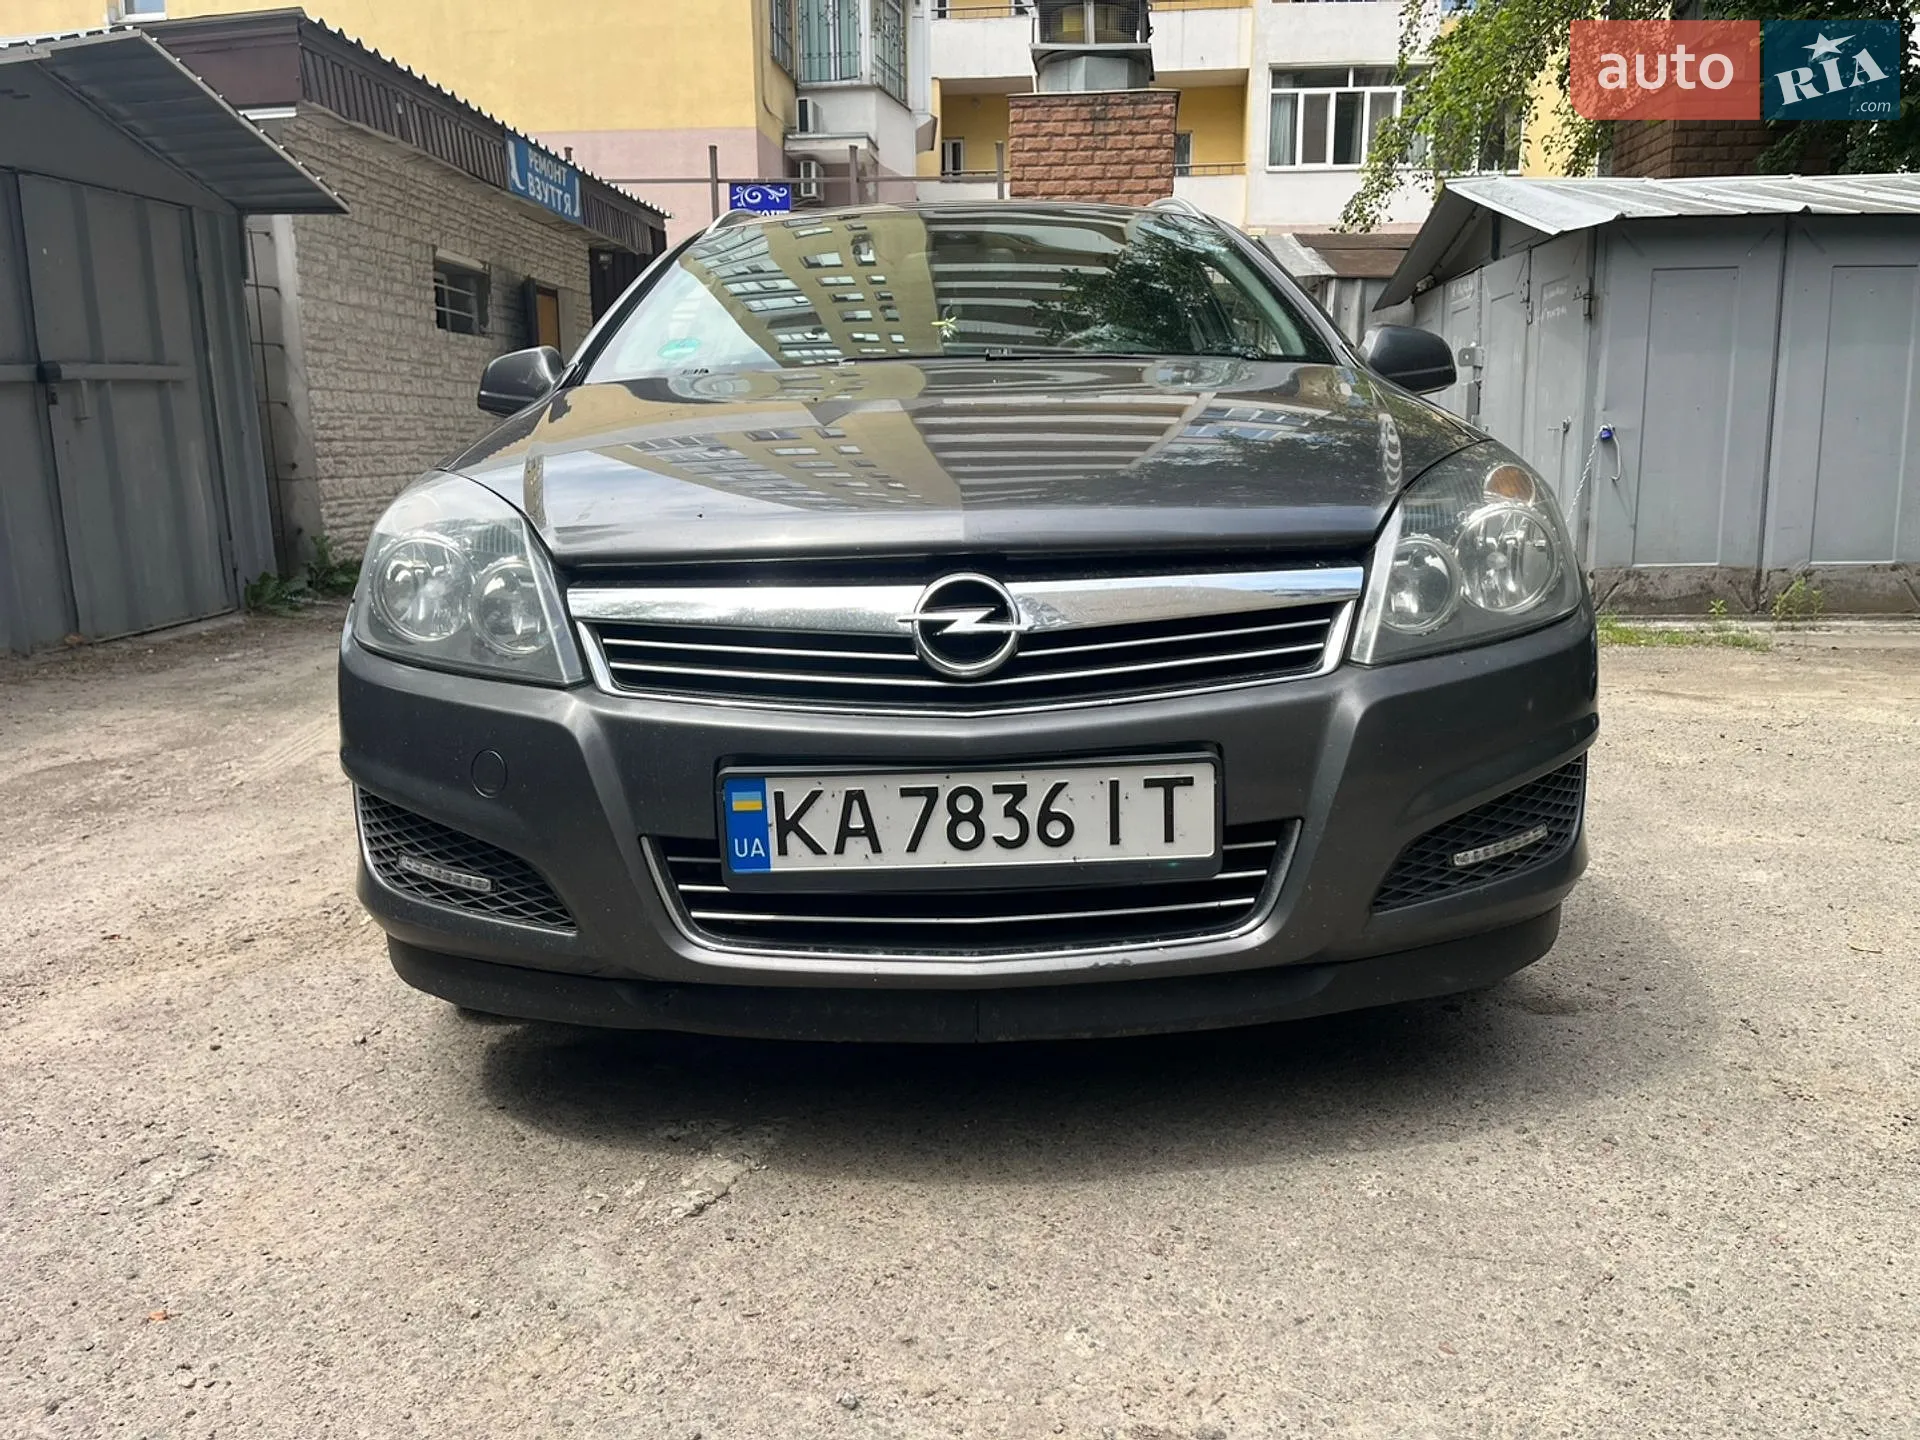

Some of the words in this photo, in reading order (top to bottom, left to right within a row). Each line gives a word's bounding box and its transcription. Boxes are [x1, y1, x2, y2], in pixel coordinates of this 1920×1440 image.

[527, 147, 568, 187] РЕМОНТ
[527, 172, 572, 216] ВЗУТТЯ
[772, 788, 883, 856] KA
[899, 781, 1075, 853] 7836
[1108, 775, 1195, 846] IT
[734, 837, 766, 858] UA
